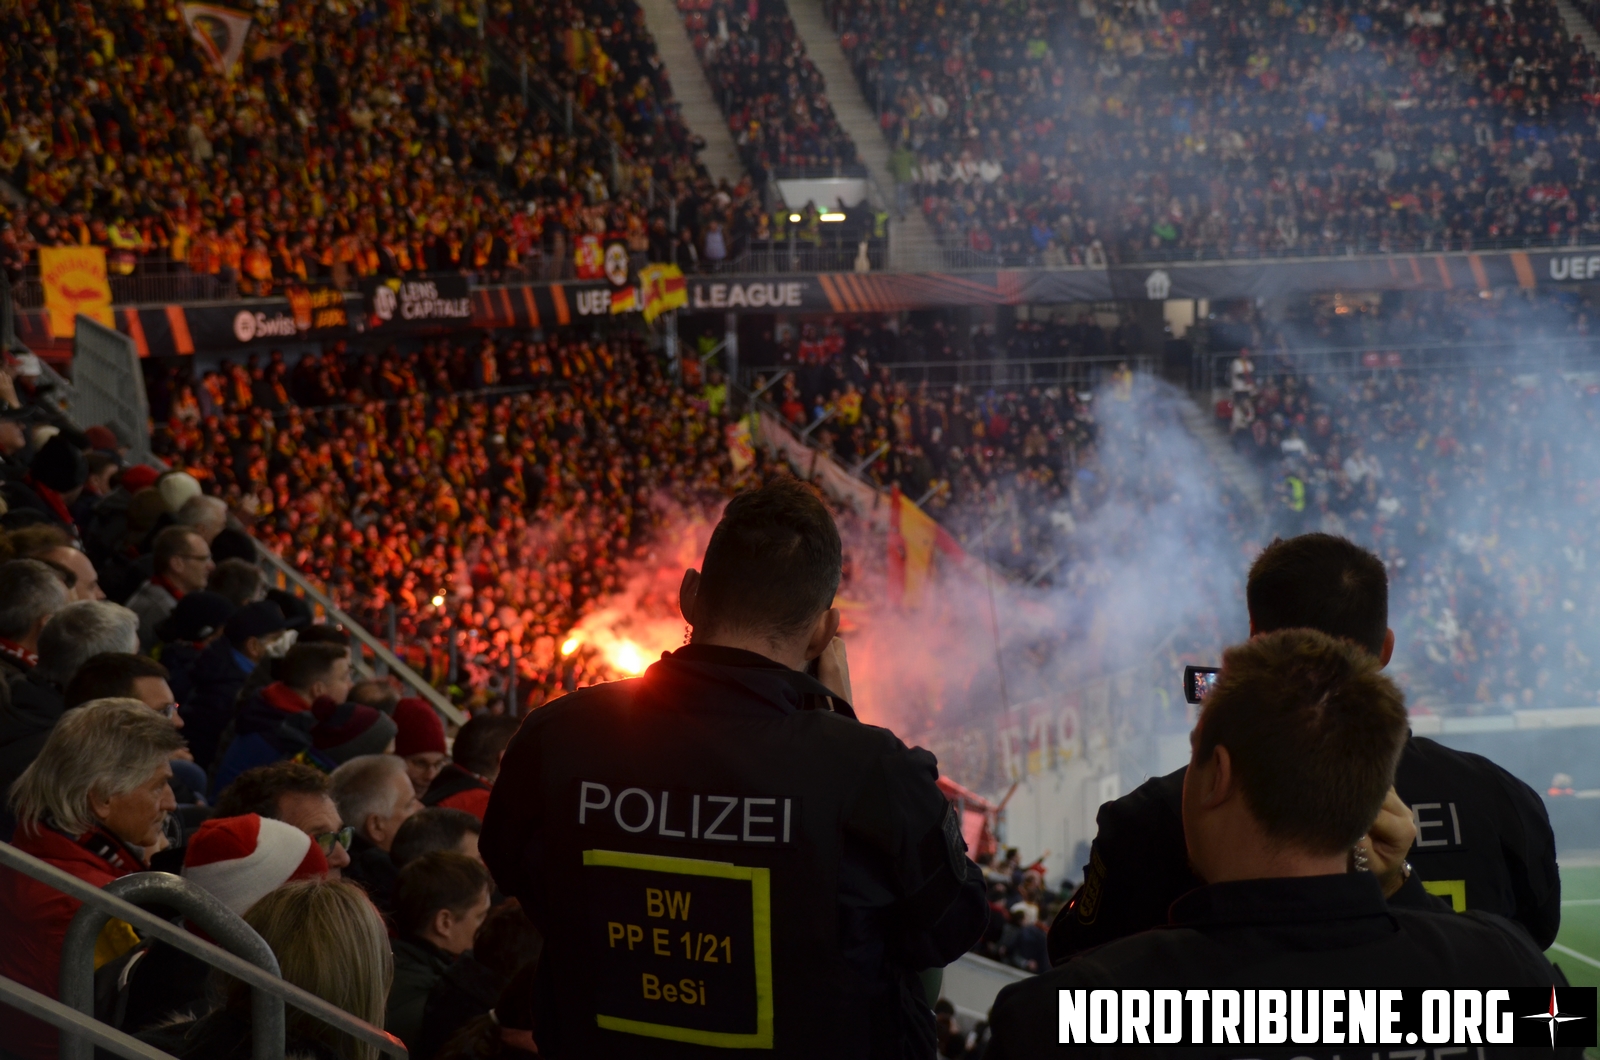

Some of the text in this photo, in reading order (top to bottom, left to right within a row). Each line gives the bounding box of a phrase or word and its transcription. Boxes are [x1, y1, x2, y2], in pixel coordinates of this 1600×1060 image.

[401, 281, 438, 300] LENS
[576, 289, 612, 316] UEF
[693, 281, 802, 309] LEAGUE
[401, 298, 470, 320] CAPITALE
[579, 781, 792, 843] POLIZEI
[646, 887, 691, 921] BW
[608, 921, 732, 964] PP E 1/21
[642, 972, 706, 1006] BeSi
